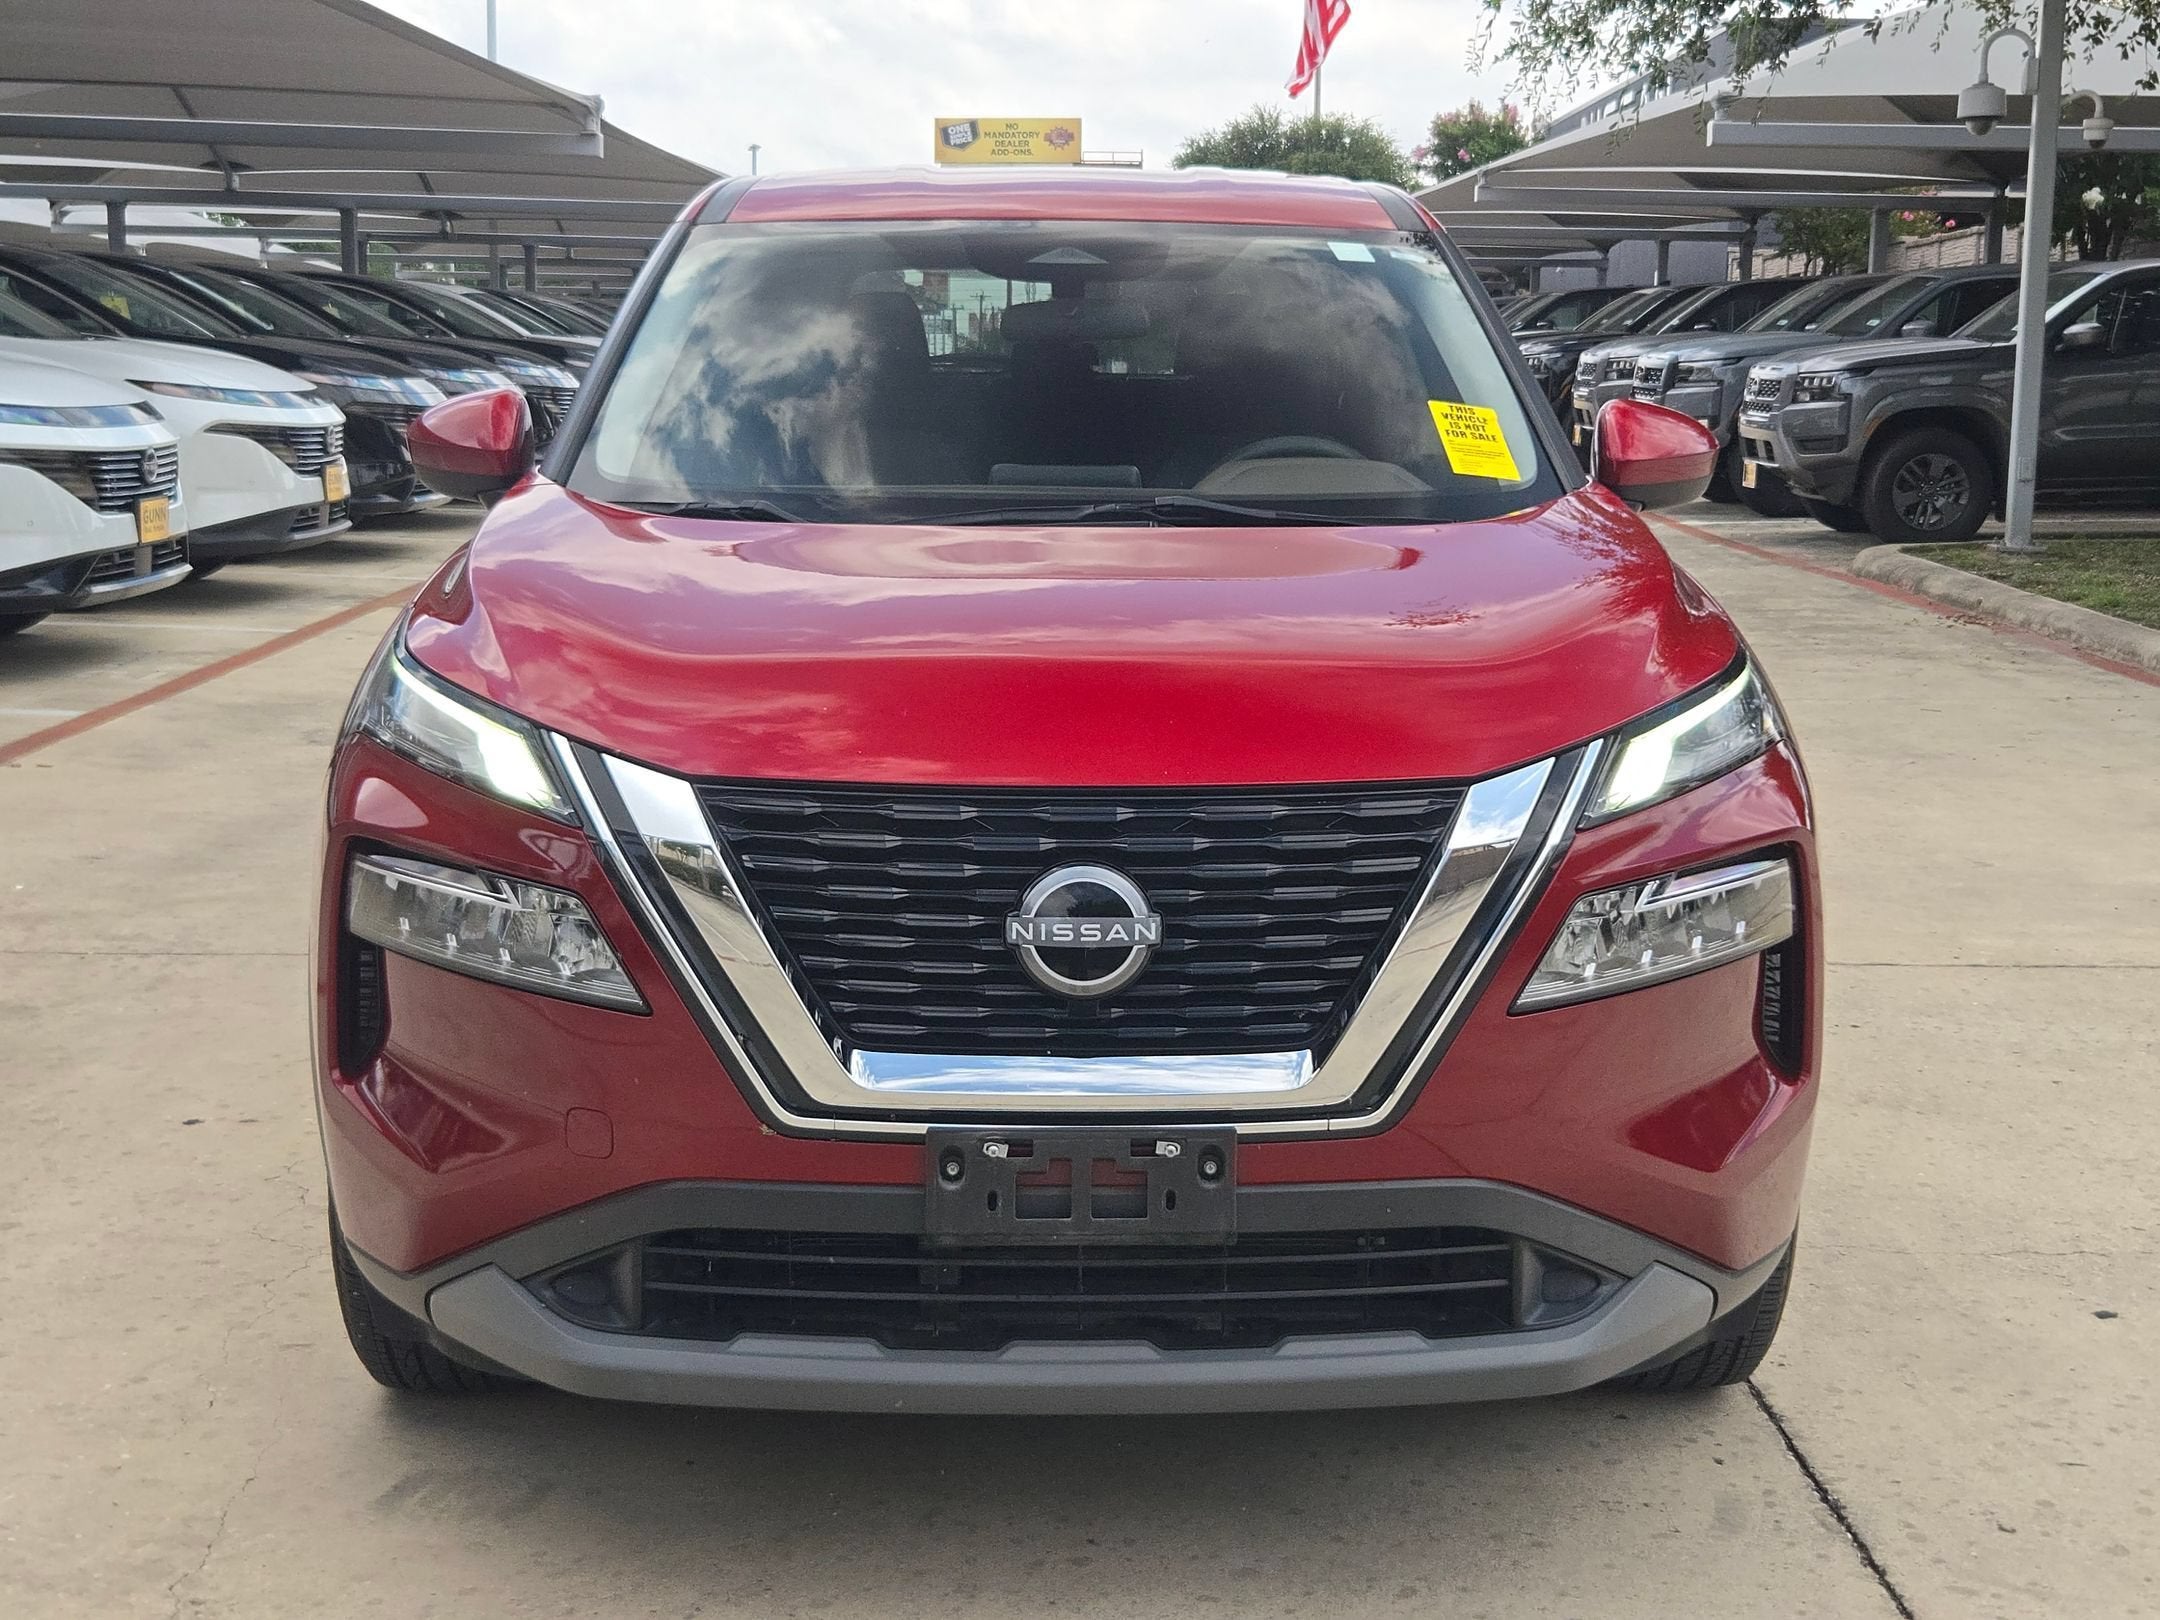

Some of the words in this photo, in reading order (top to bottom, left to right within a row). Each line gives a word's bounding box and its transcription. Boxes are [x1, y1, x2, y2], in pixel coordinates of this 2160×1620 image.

[948, 123, 970, 134] ONE
[1005, 122, 1019, 130] NO
[983, 131, 1040, 139] MANDATORY
[950, 136, 973, 146] PRICE
[1448, 405, 1476, 416] THIS
[1440, 412, 1488, 425] VEHICLE
[1449, 421, 1462, 430] IS
[1465, 423, 1486, 433] NOT
[1445, 429, 1467, 438] FOR
[1470, 432, 1498, 443] SALE
[143, 506, 167, 524] GUNN
[1011, 922, 1156, 942] NISSAN
